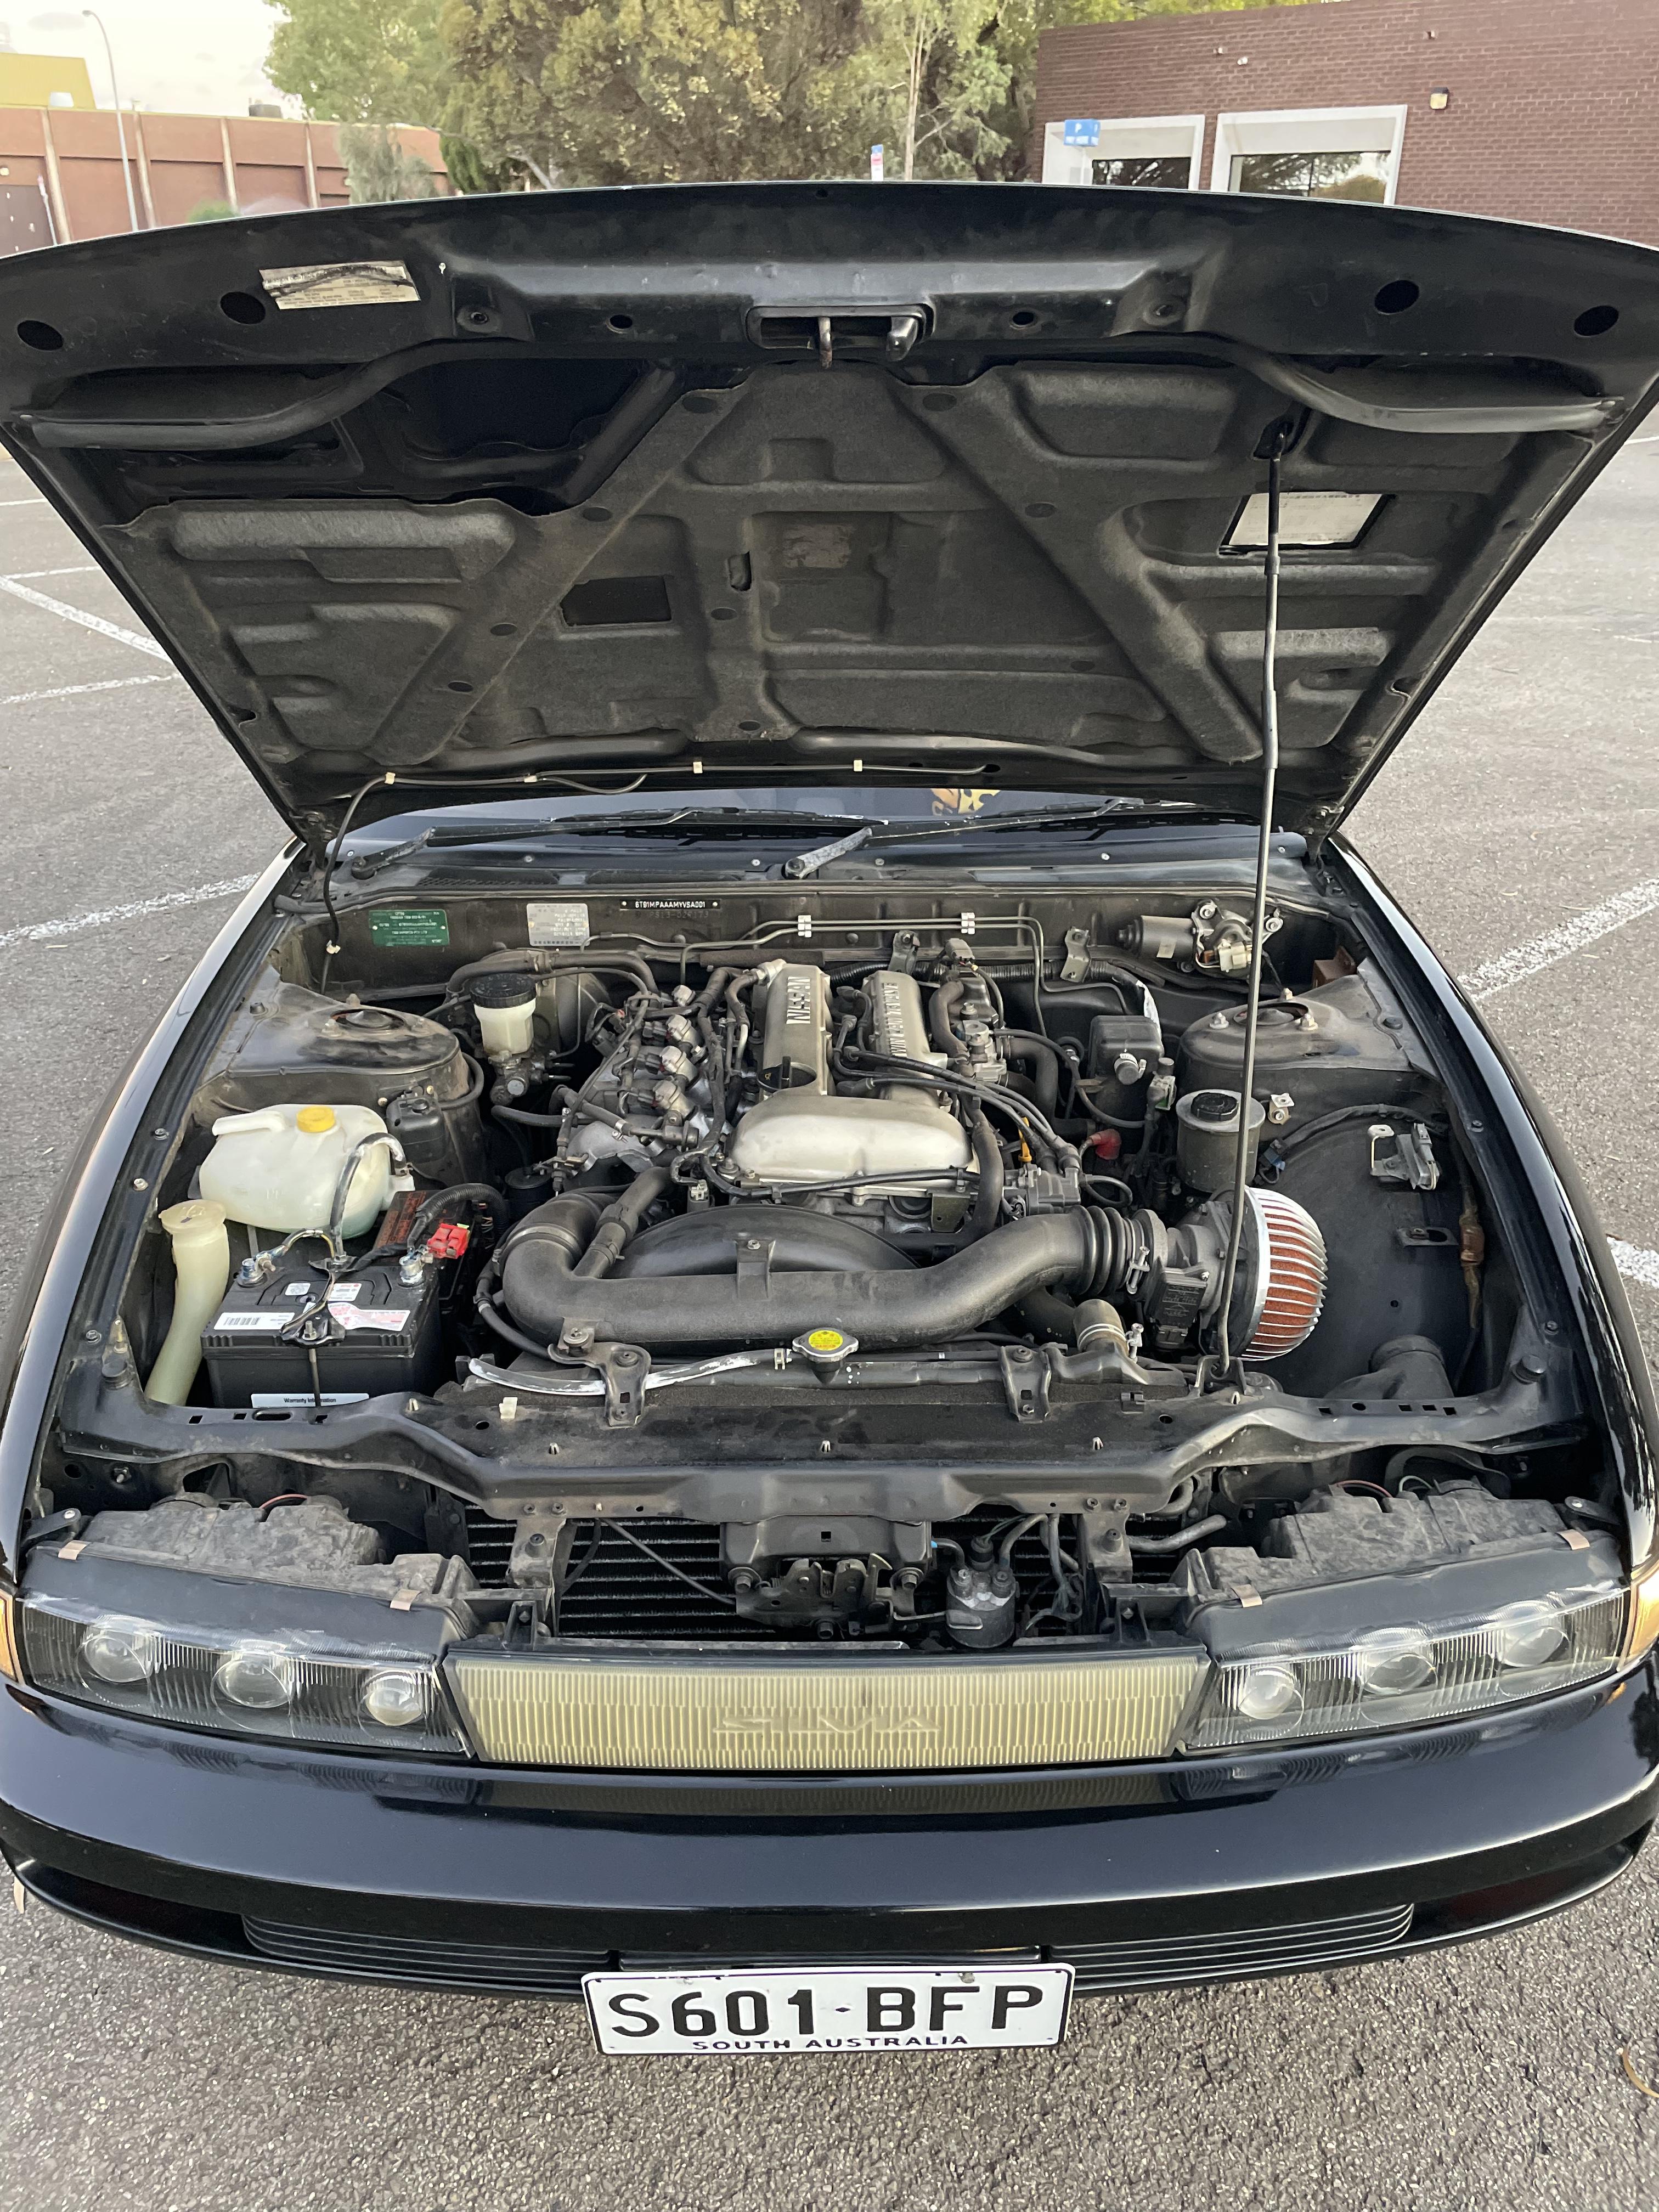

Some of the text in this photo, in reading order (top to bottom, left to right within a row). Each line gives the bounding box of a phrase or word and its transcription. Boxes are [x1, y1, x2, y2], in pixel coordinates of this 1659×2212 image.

[786, 976, 811, 1024] NISSAN
[713, 1714, 941, 1733] SILVIA
[692, 2034, 969, 2051] SOUTH AUSTRALIA
